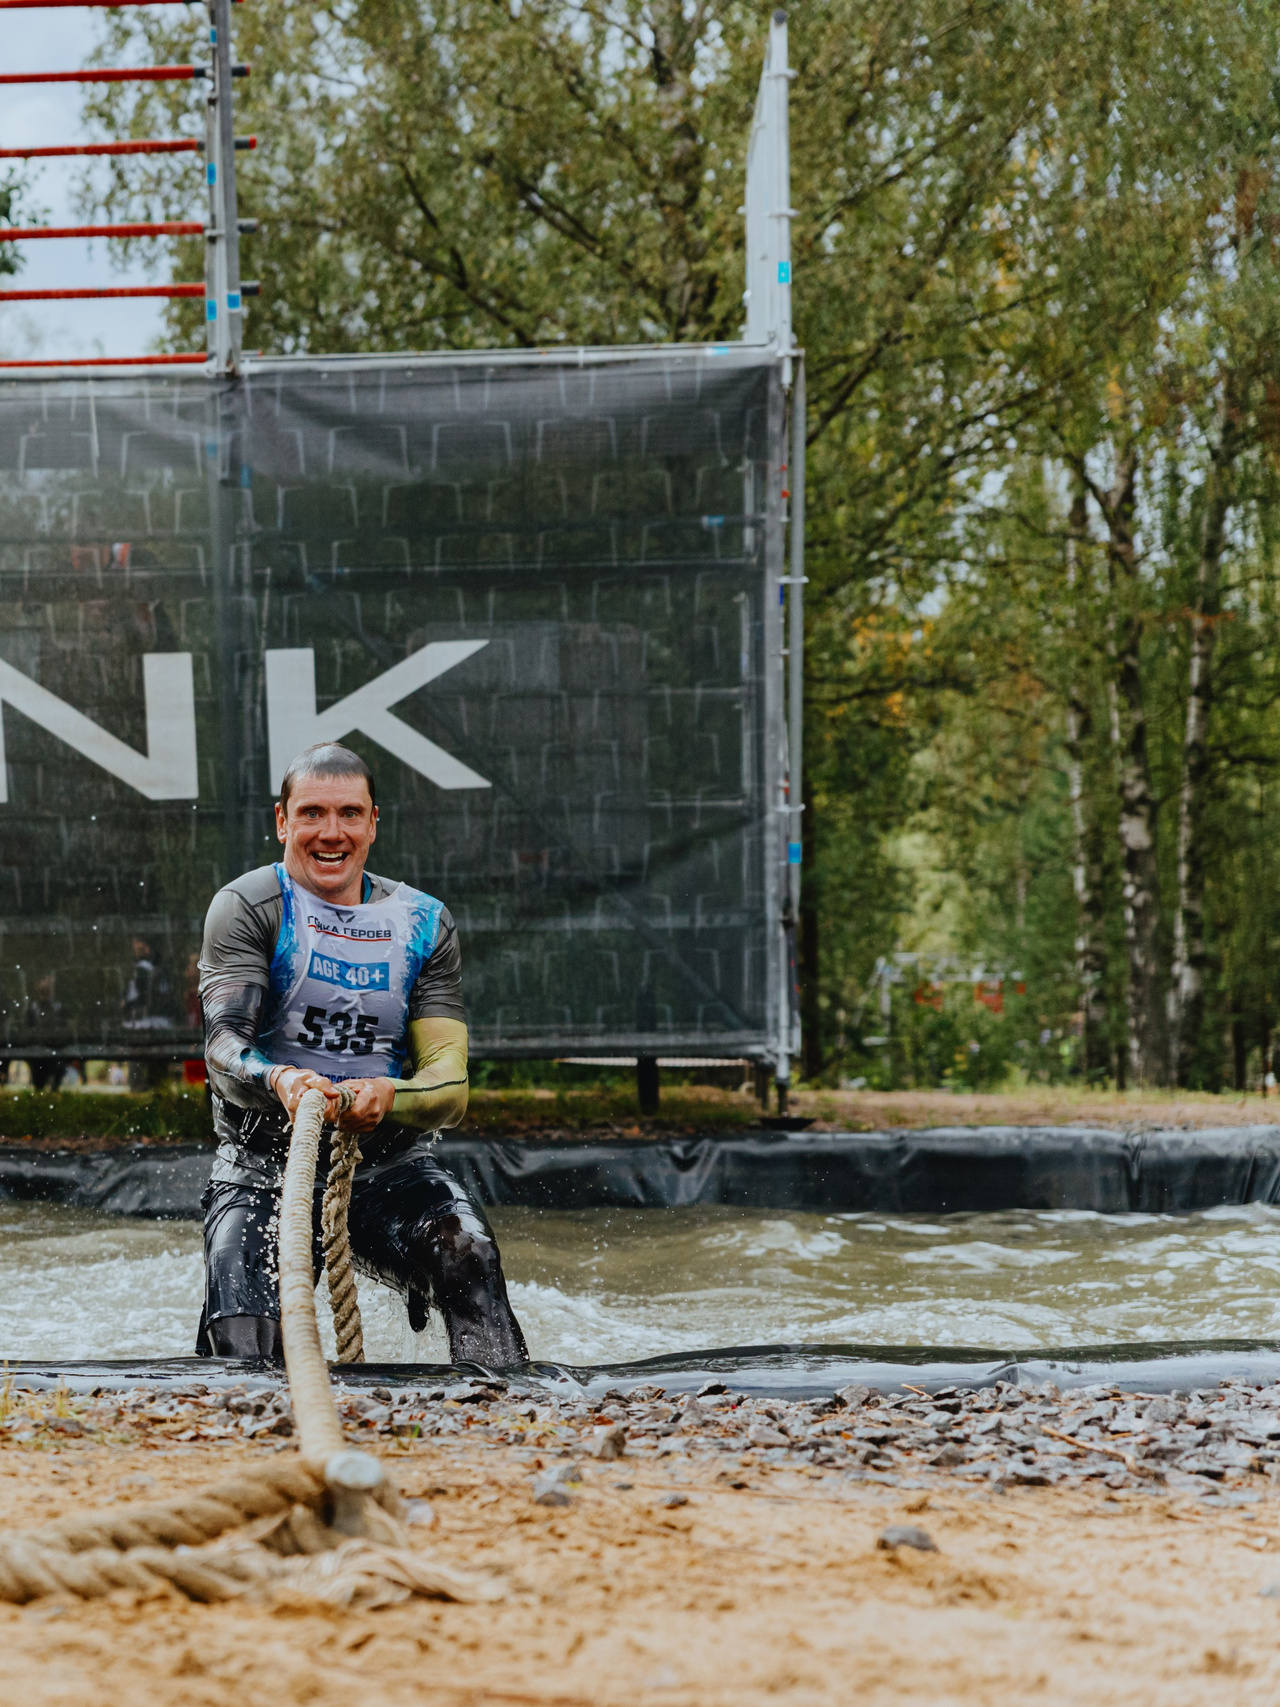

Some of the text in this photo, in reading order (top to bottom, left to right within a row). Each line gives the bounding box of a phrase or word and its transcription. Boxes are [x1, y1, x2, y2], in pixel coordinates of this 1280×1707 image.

[344, 927, 391, 938] ГЕРОЕВ
[313, 955, 384, 986] AGE 40+
[297, 1005, 379, 1055] 535
